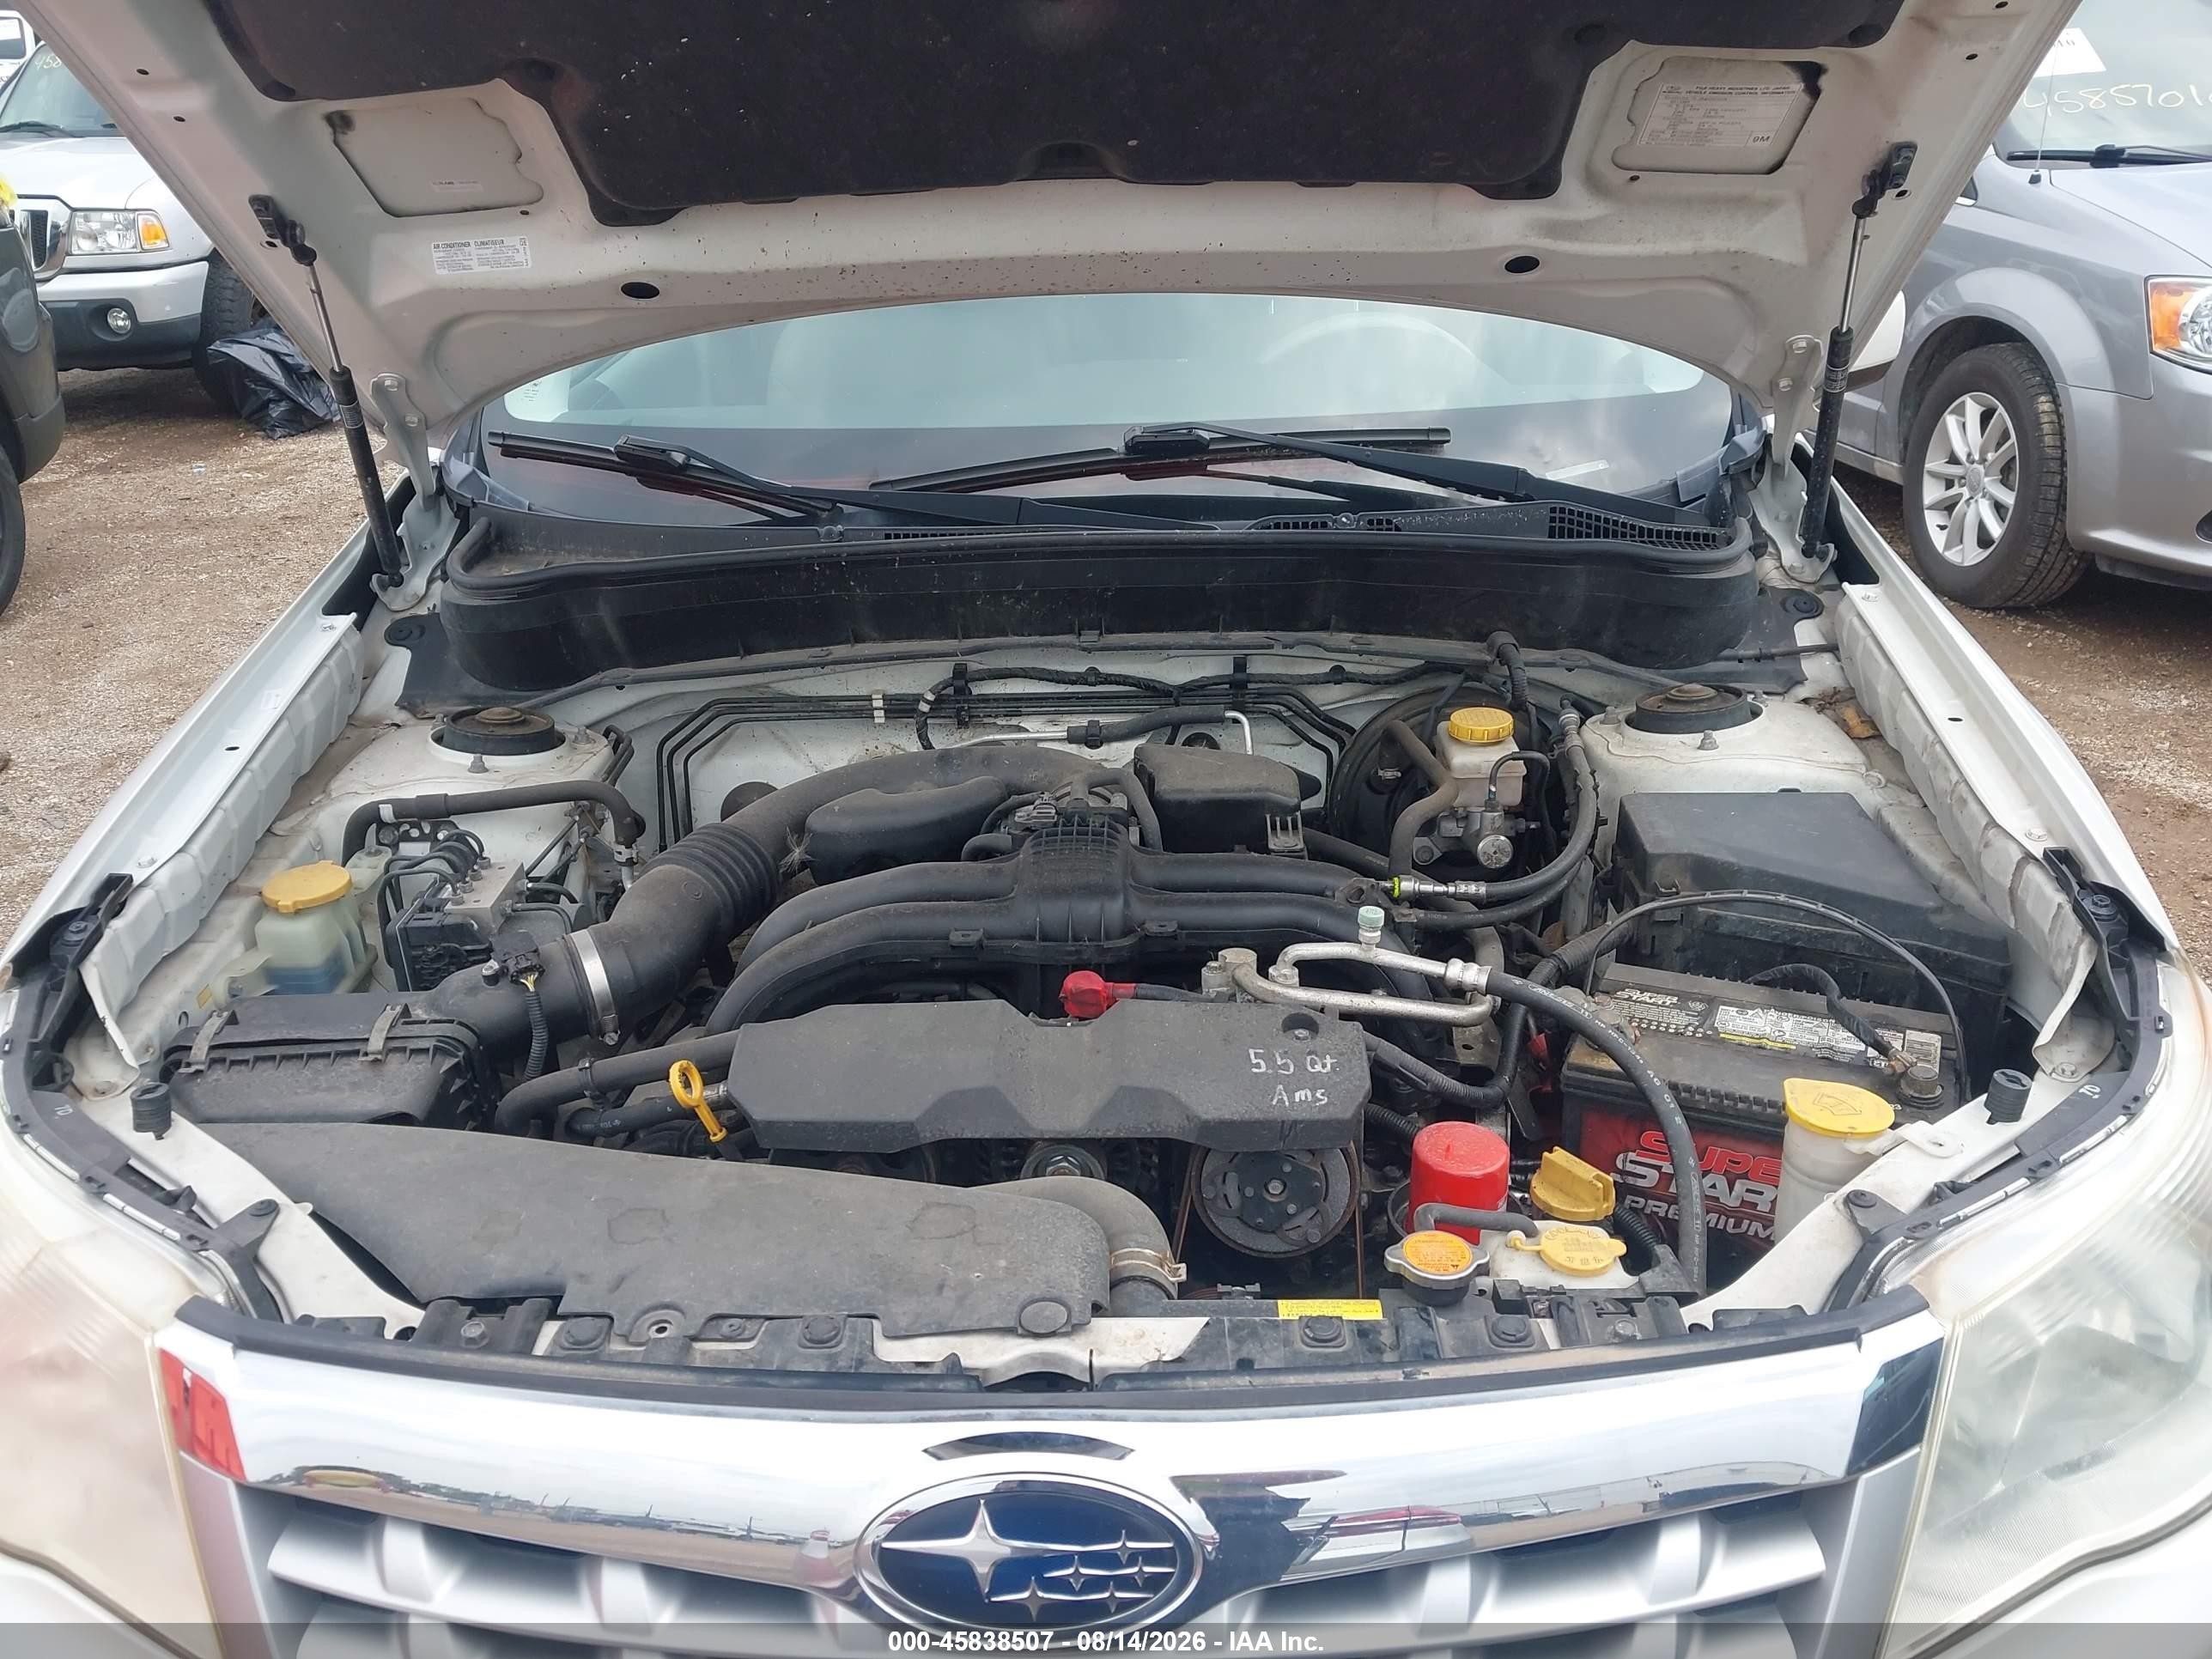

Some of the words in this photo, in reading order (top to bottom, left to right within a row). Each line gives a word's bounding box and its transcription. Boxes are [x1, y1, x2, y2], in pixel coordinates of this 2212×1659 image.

[2022, 83, 2212, 117] 4585701
[1613, 991, 1677, 1006] START
[1625, 988, 1679, 1003] SUPER
